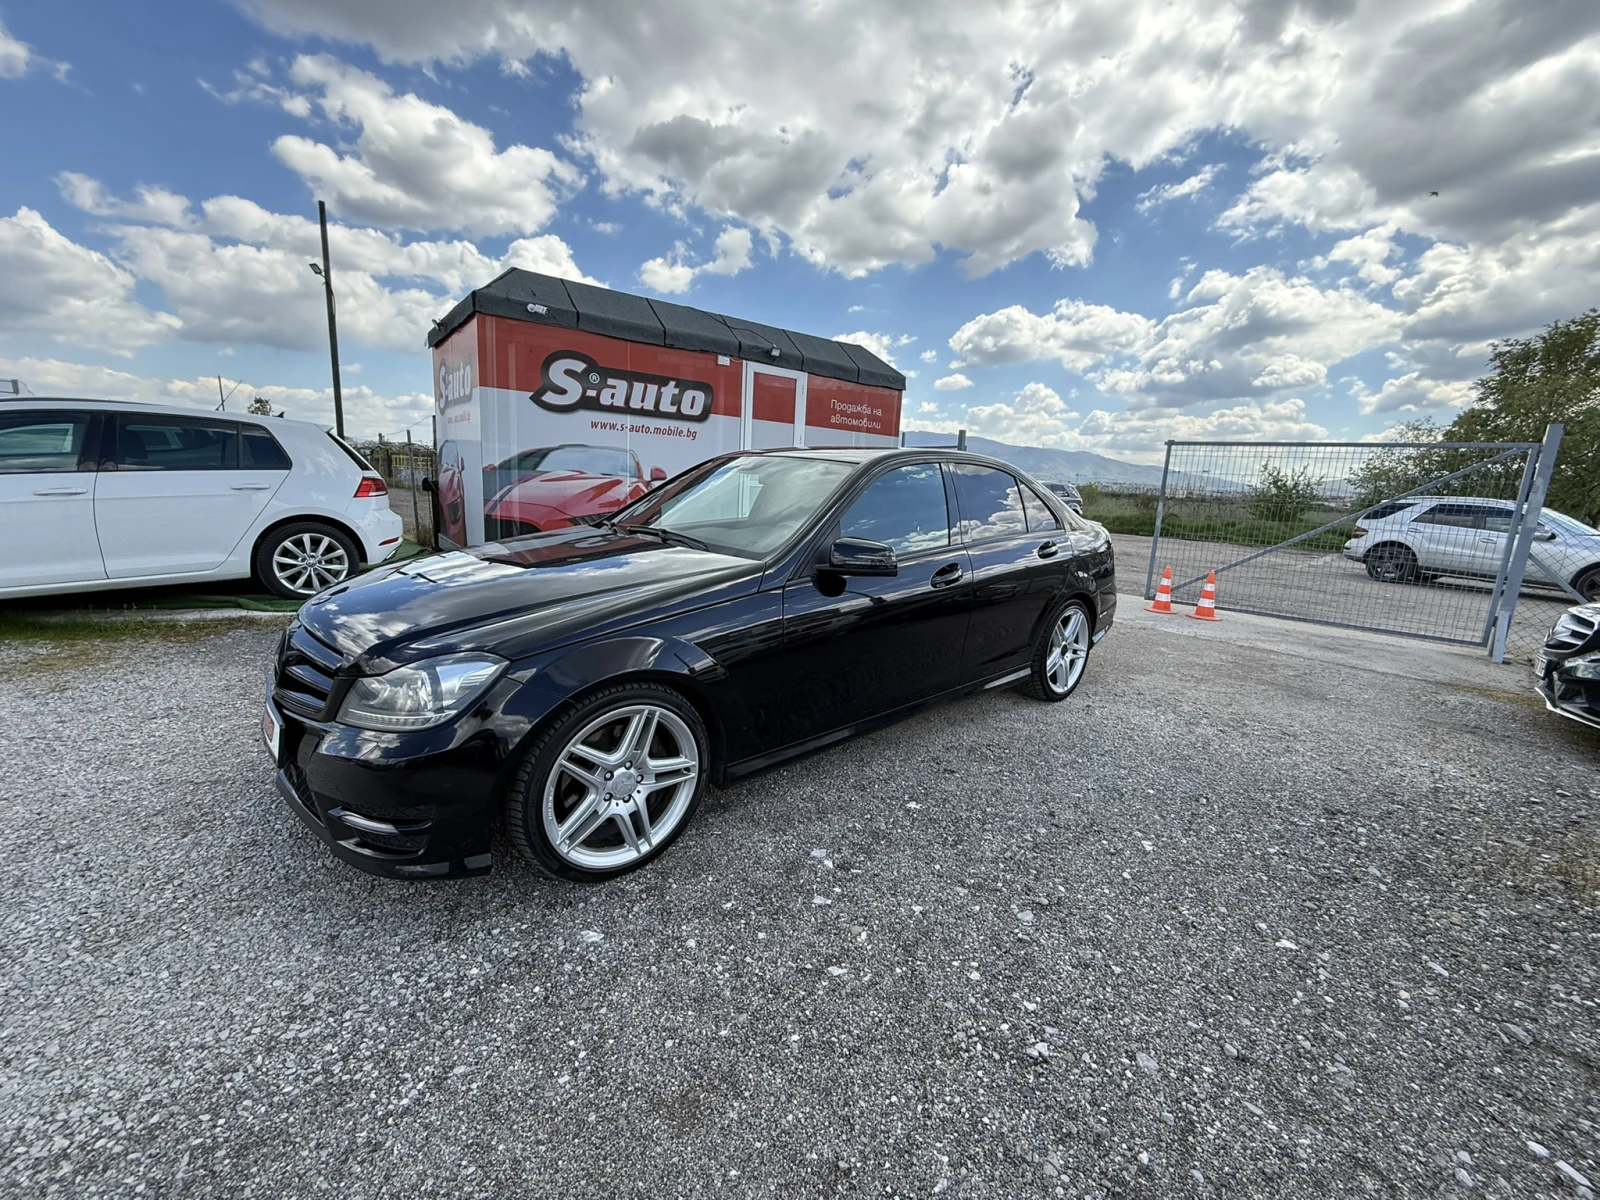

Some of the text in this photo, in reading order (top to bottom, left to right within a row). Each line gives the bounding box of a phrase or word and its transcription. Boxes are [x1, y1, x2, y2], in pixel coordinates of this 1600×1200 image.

[830, 399, 882, 416] Продажба на
[590, 420, 697, 440] www.s-auto.mobile.bg
[830, 414, 881, 429] автомобили
